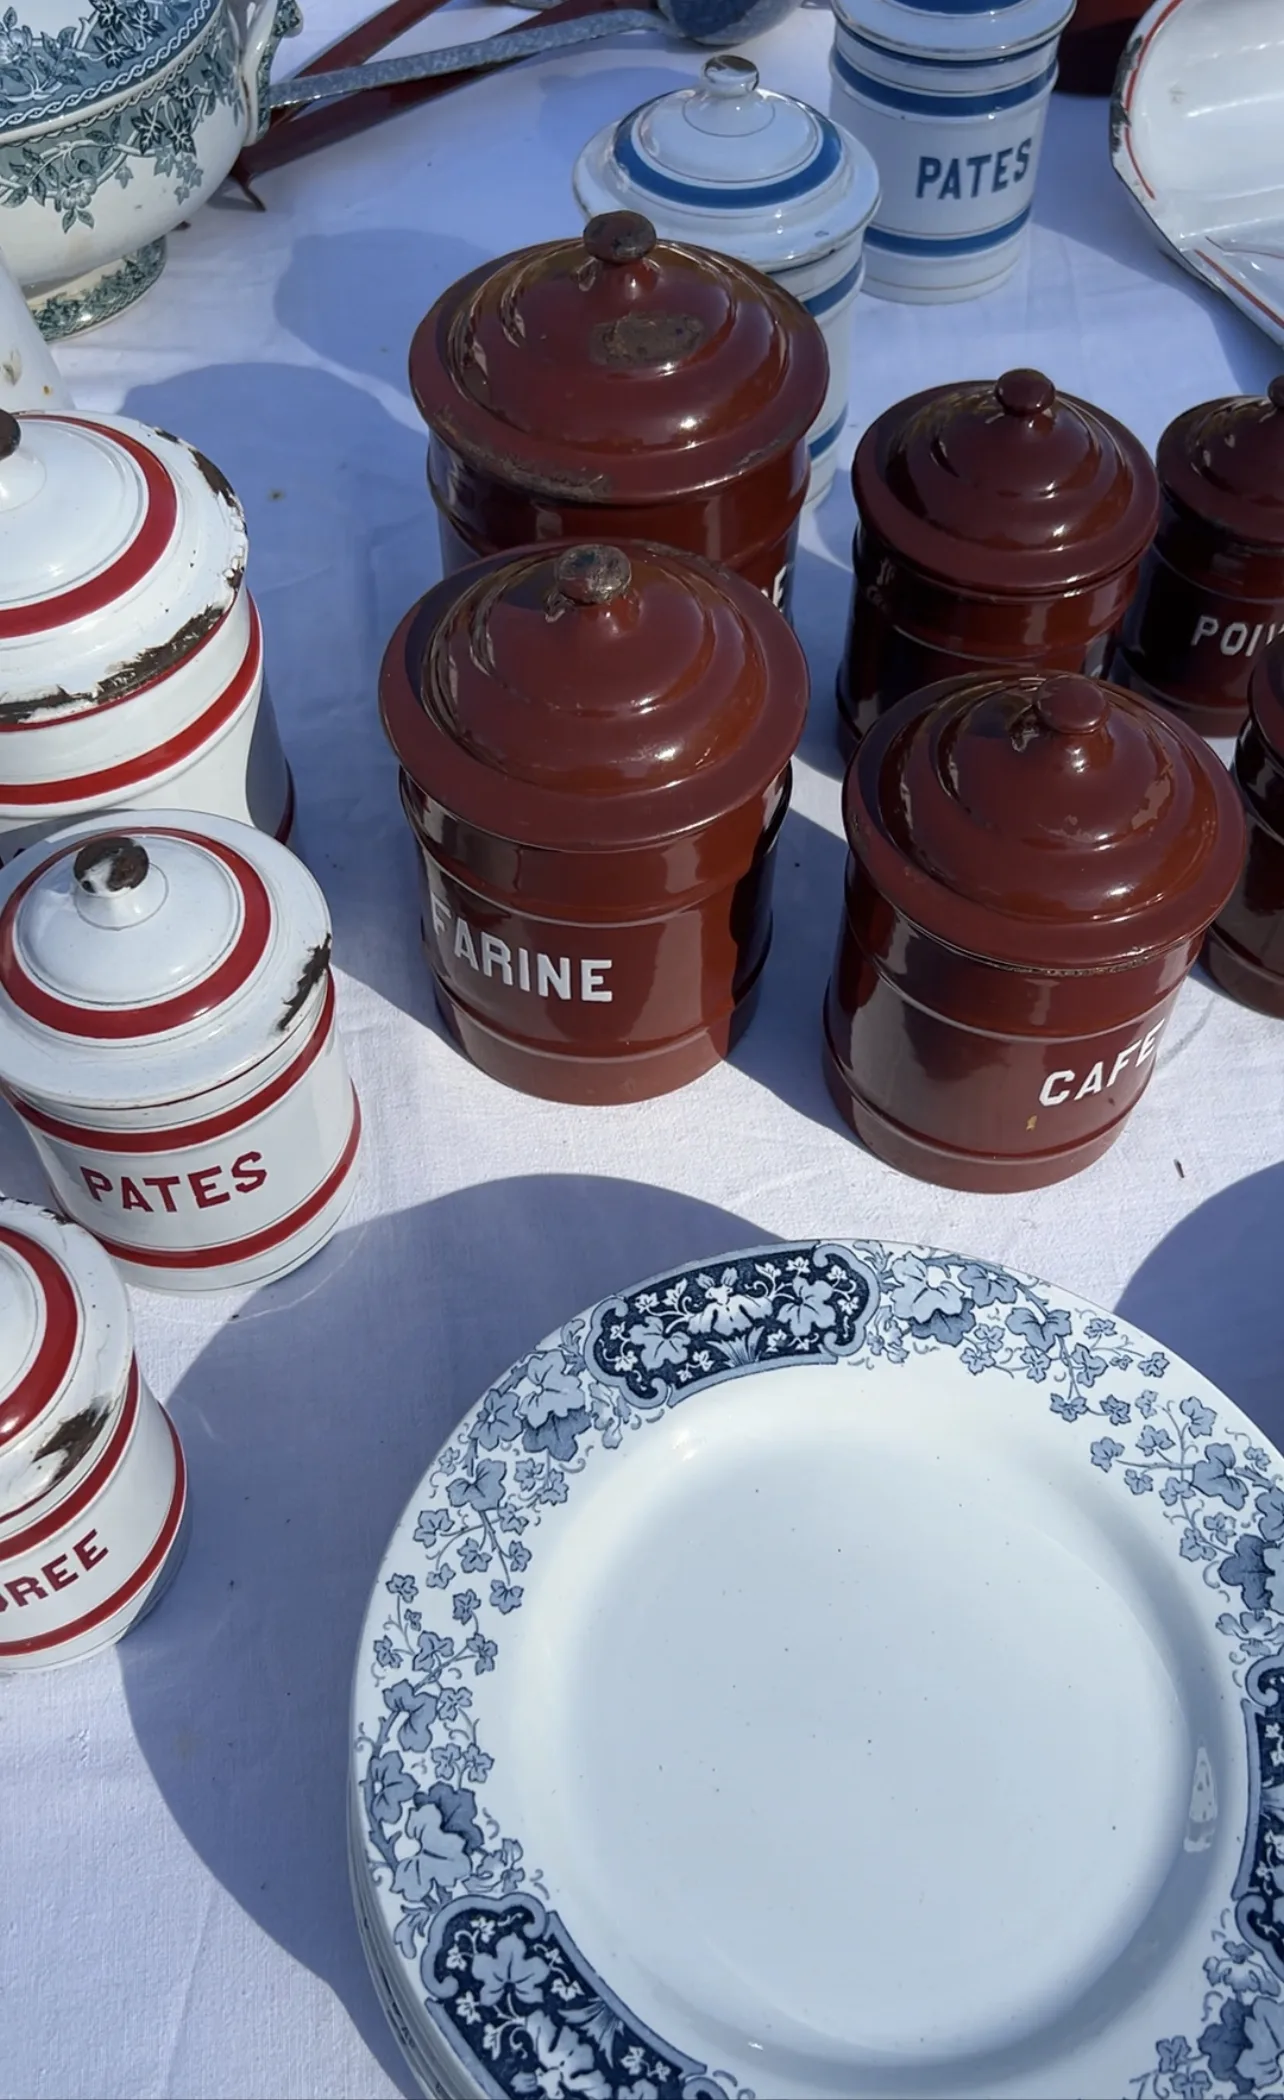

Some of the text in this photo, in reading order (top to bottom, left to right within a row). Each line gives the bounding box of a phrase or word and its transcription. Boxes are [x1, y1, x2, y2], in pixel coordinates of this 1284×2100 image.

[916, 137, 1032, 200] PATES
[429, 892, 613, 1002] FARINE
[1039, 1018, 1165, 1107] CAFE
[80, 1151, 268, 1213] PATES
[0, 1528, 109, 1613] REE
